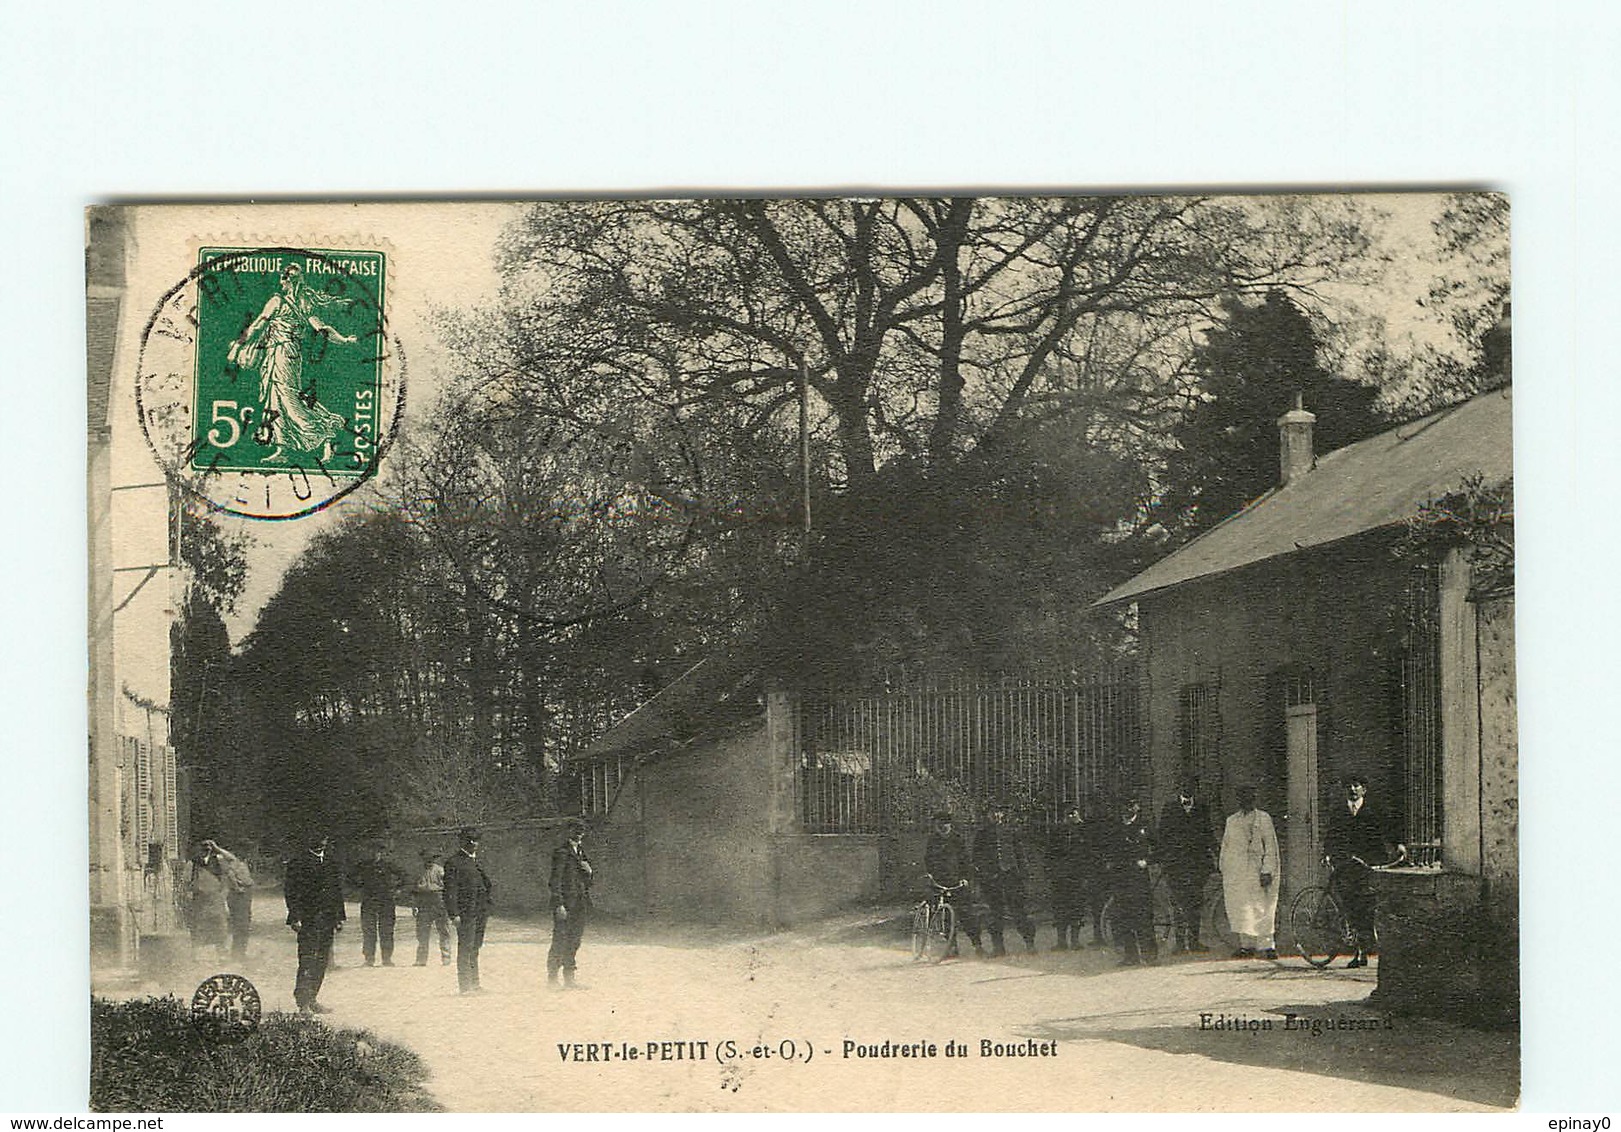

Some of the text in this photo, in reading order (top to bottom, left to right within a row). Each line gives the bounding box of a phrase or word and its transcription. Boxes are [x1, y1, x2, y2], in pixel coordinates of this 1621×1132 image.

[354, 390, 373, 463] POSTES
[1200, 1013, 1272, 1036] Edition
[557, 1041, 709, 1062] VERT-le-PETIT
[715, 1039, 814, 1064] (S.-et-O.)
[842, 1039, 938, 1059] Poudrerie
[945, 1039, 968, 1058] du
[980, 1038, 1058, 1058] Bouchet
